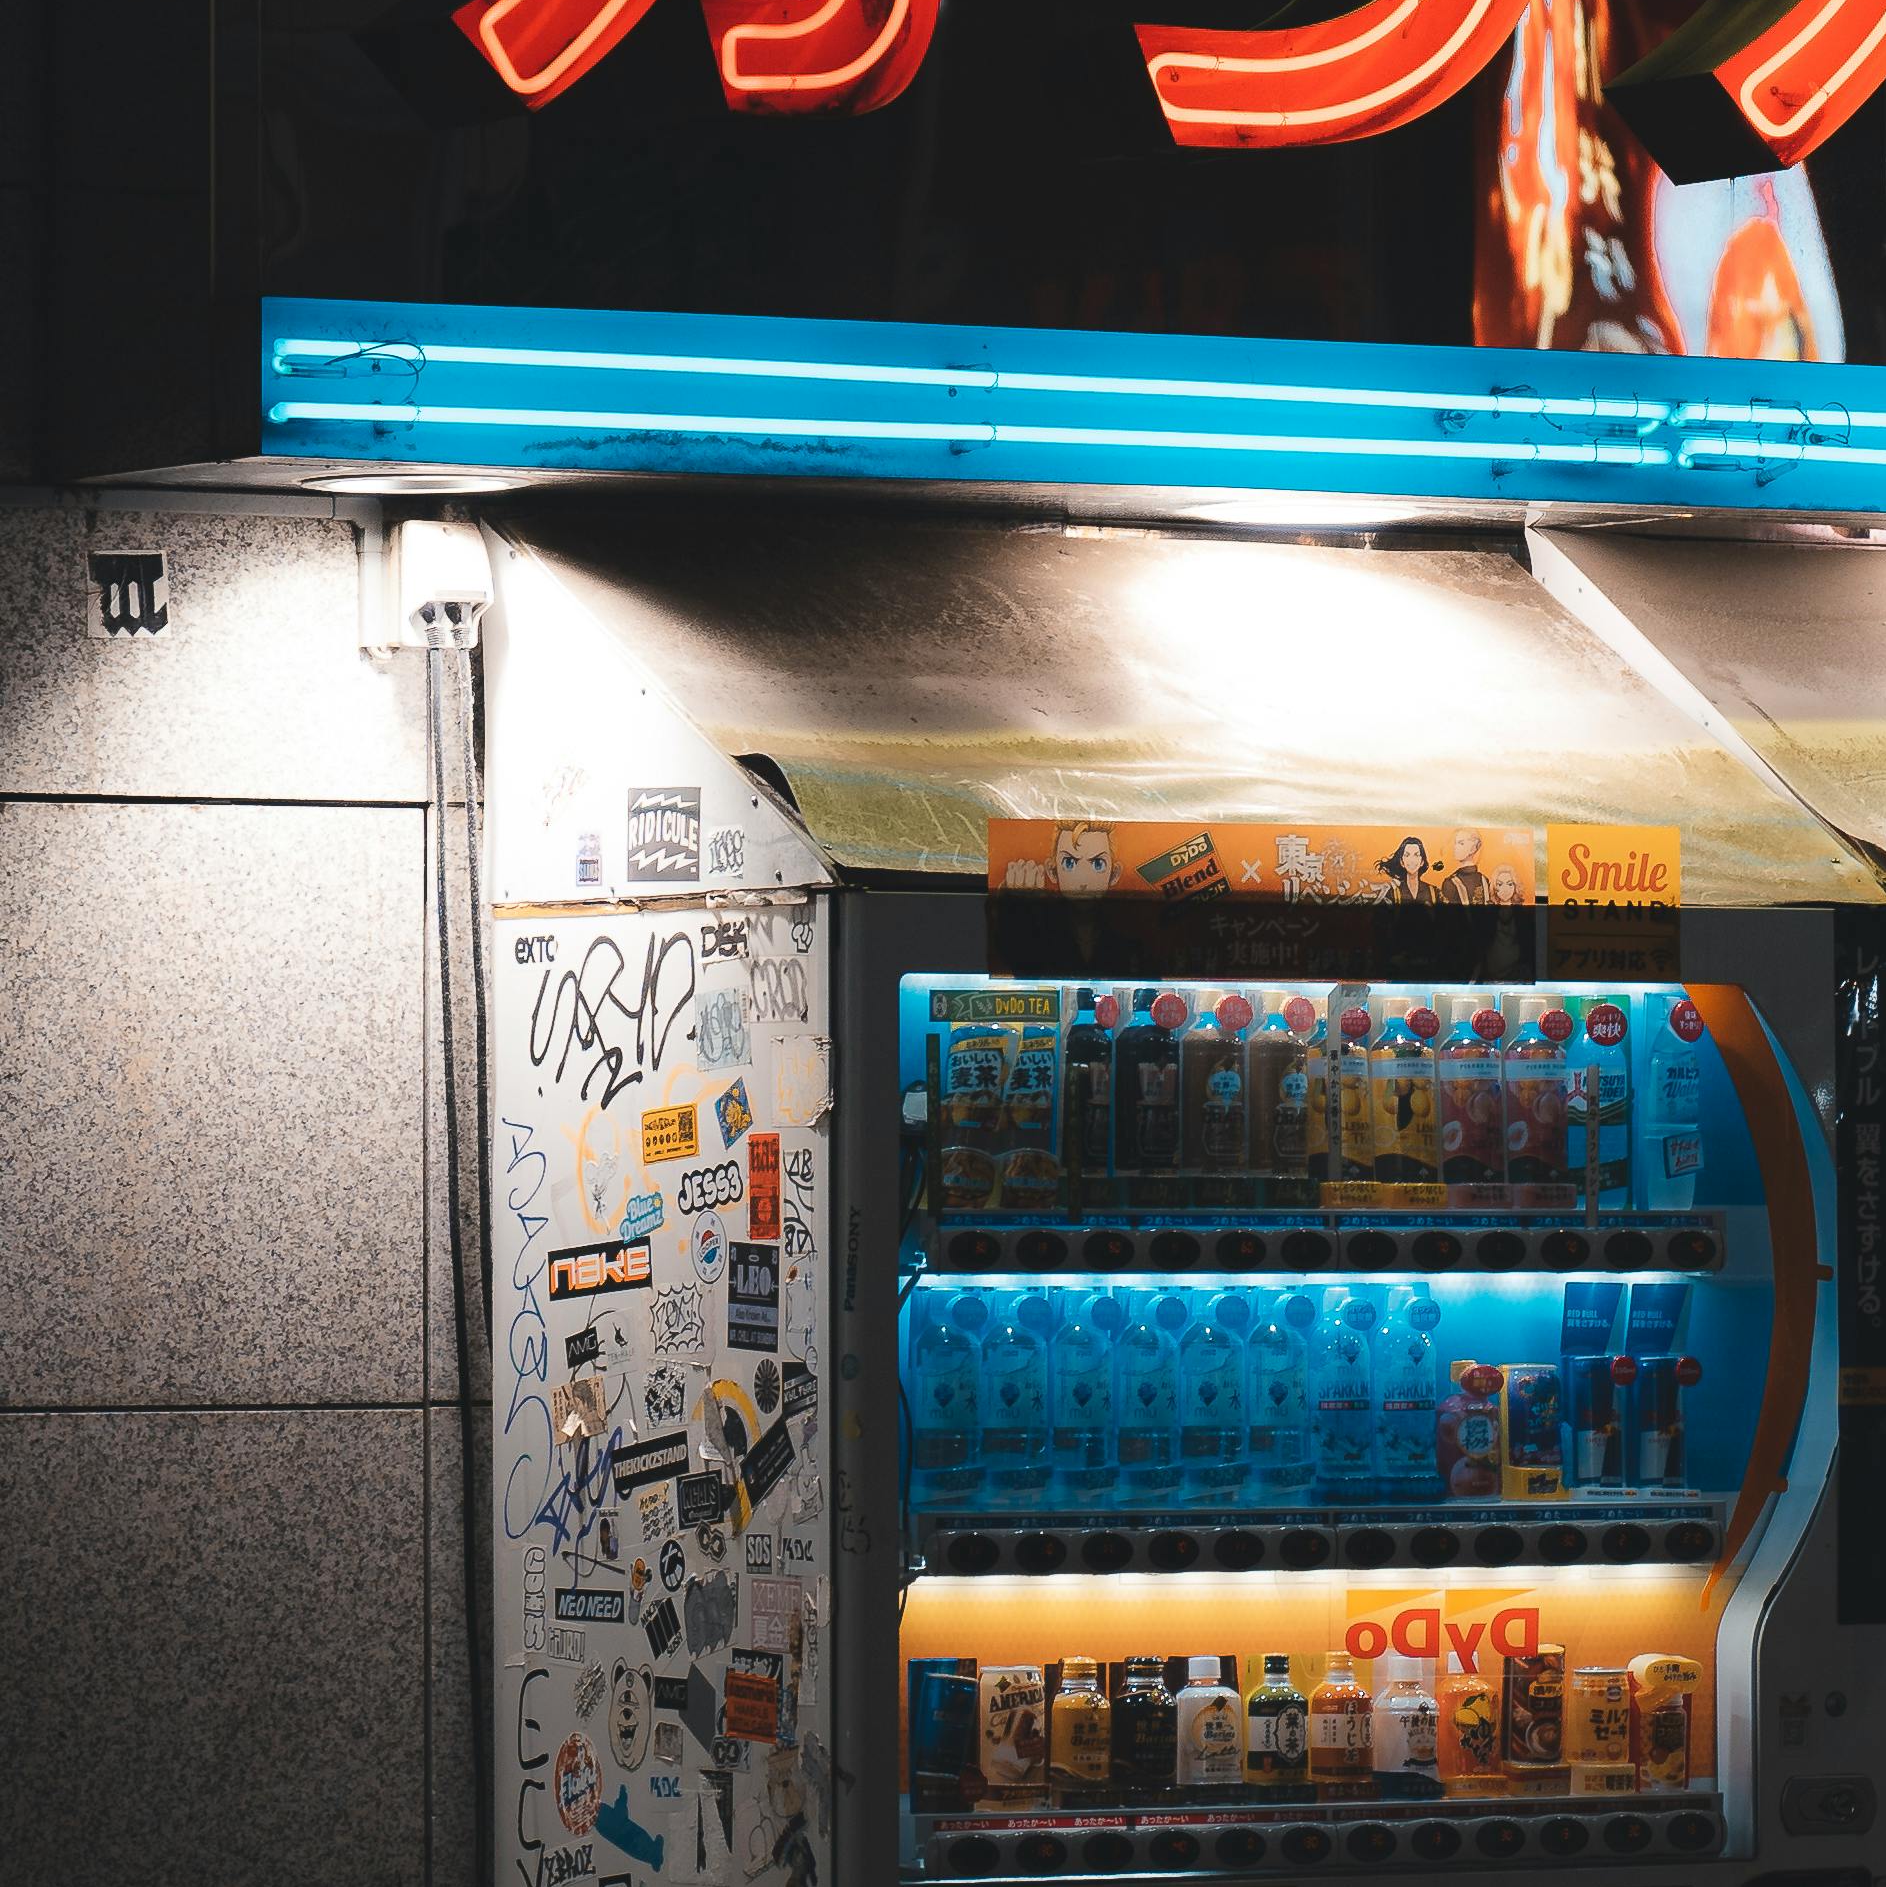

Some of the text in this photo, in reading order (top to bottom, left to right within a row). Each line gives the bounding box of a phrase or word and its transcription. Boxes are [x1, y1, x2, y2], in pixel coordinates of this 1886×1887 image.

[628, 809, 700, 853] RIDICULE
[1171, 840, 1211, 867] DyDo
[1163, 859, 1219, 900] Blend
[1562, 843, 1667, 894] Smile
[1563, 898, 1667, 923] STAND
[1209, 912, 1320, 939] キャンペーン
[1555, 948, 1646, 972] アプリ対応
[1026, 997, 1051, 1015] TEA
[1592, 1023, 1622, 1039] 爽快
[949, 1051, 998, 1068] おいしい
[949, 1067, 1000, 1091] 麦茶
[1009, 1067, 1053, 1090] 麦茶
[678, 1160, 744, 1215] JESS3
[627, 1193, 655, 1219] Blue
[1855, 1123, 1882, 1329] 翼をさずける。
[737, 1264, 772, 1298] LEO
[747, 1535, 771, 1564] SOS
[558, 1592, 622, 1620] NEO NEED
[1284, 1713, 1298, 1757] 葉の茶
